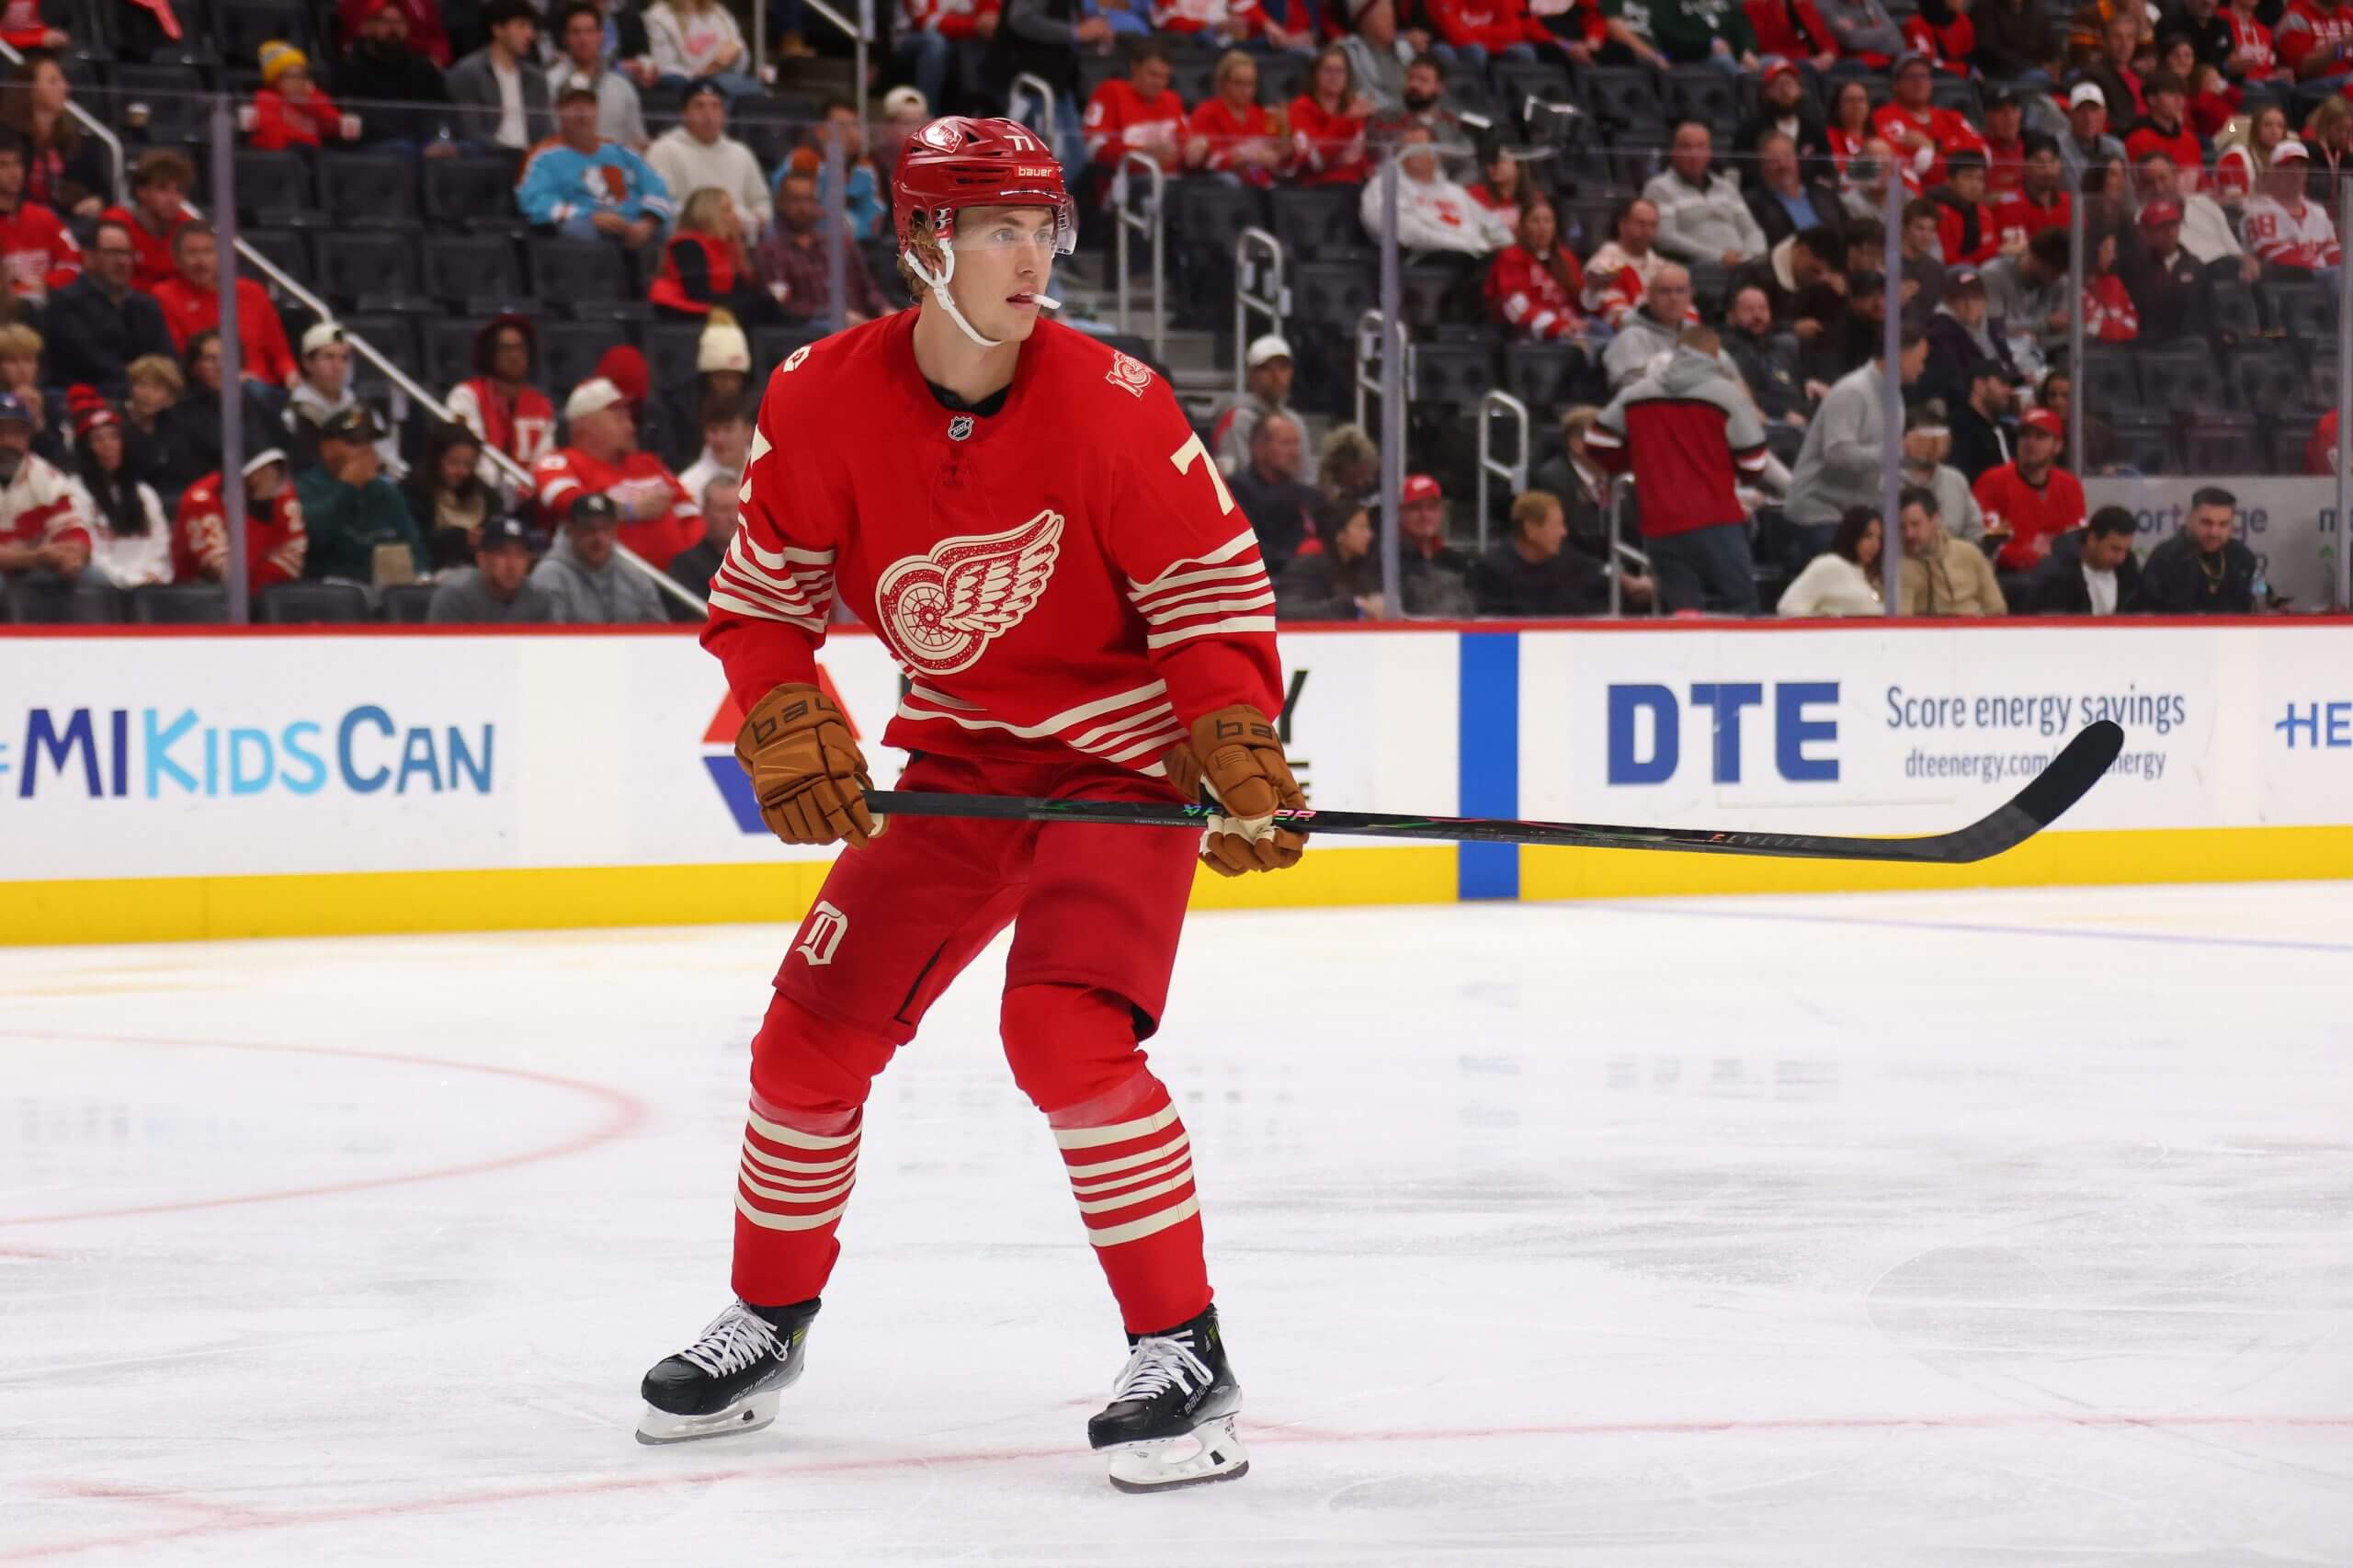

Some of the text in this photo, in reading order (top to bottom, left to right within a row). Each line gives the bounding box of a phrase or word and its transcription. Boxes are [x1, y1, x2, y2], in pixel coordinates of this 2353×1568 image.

[1018, 166, 1052, 177] bauer
[1608, 683, 1839, 785] DTE
[1887, 685, 2185, 736] Score energy savings
